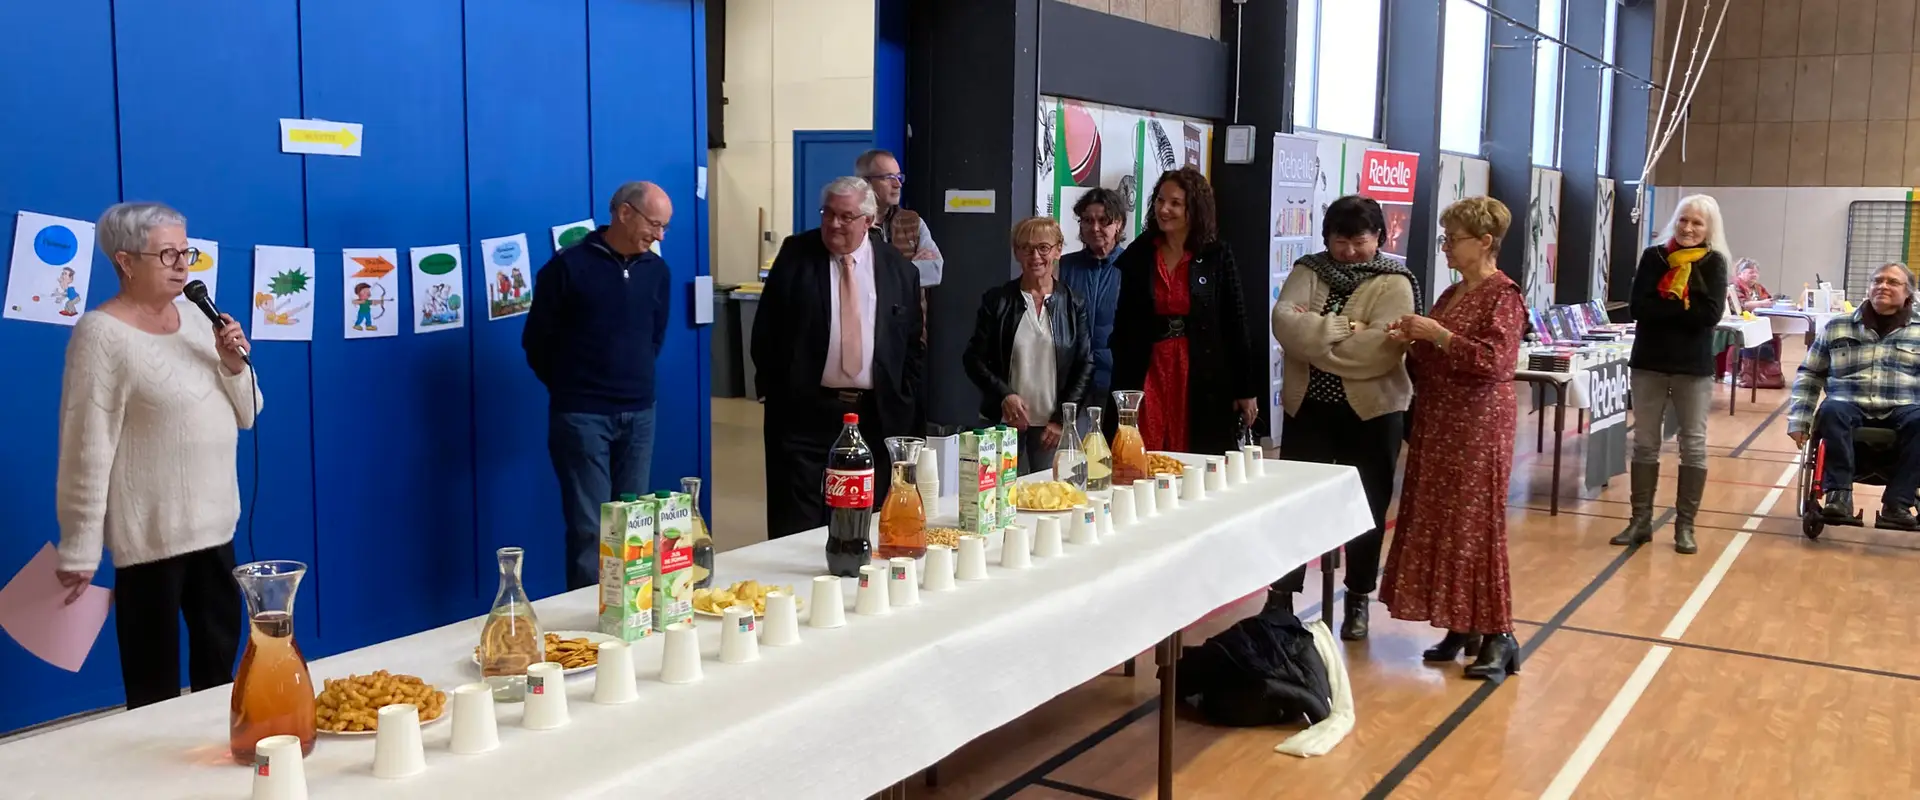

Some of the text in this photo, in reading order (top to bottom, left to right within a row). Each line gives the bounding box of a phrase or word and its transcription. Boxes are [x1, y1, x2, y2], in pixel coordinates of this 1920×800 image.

[1278, 149, 1314, 180] Rebelle
[1369, 157, 1411, 187] Rebelle
[1591, 363, 1627, 419] Rebelle
[660, 508, 689, 522] PAQUITO
